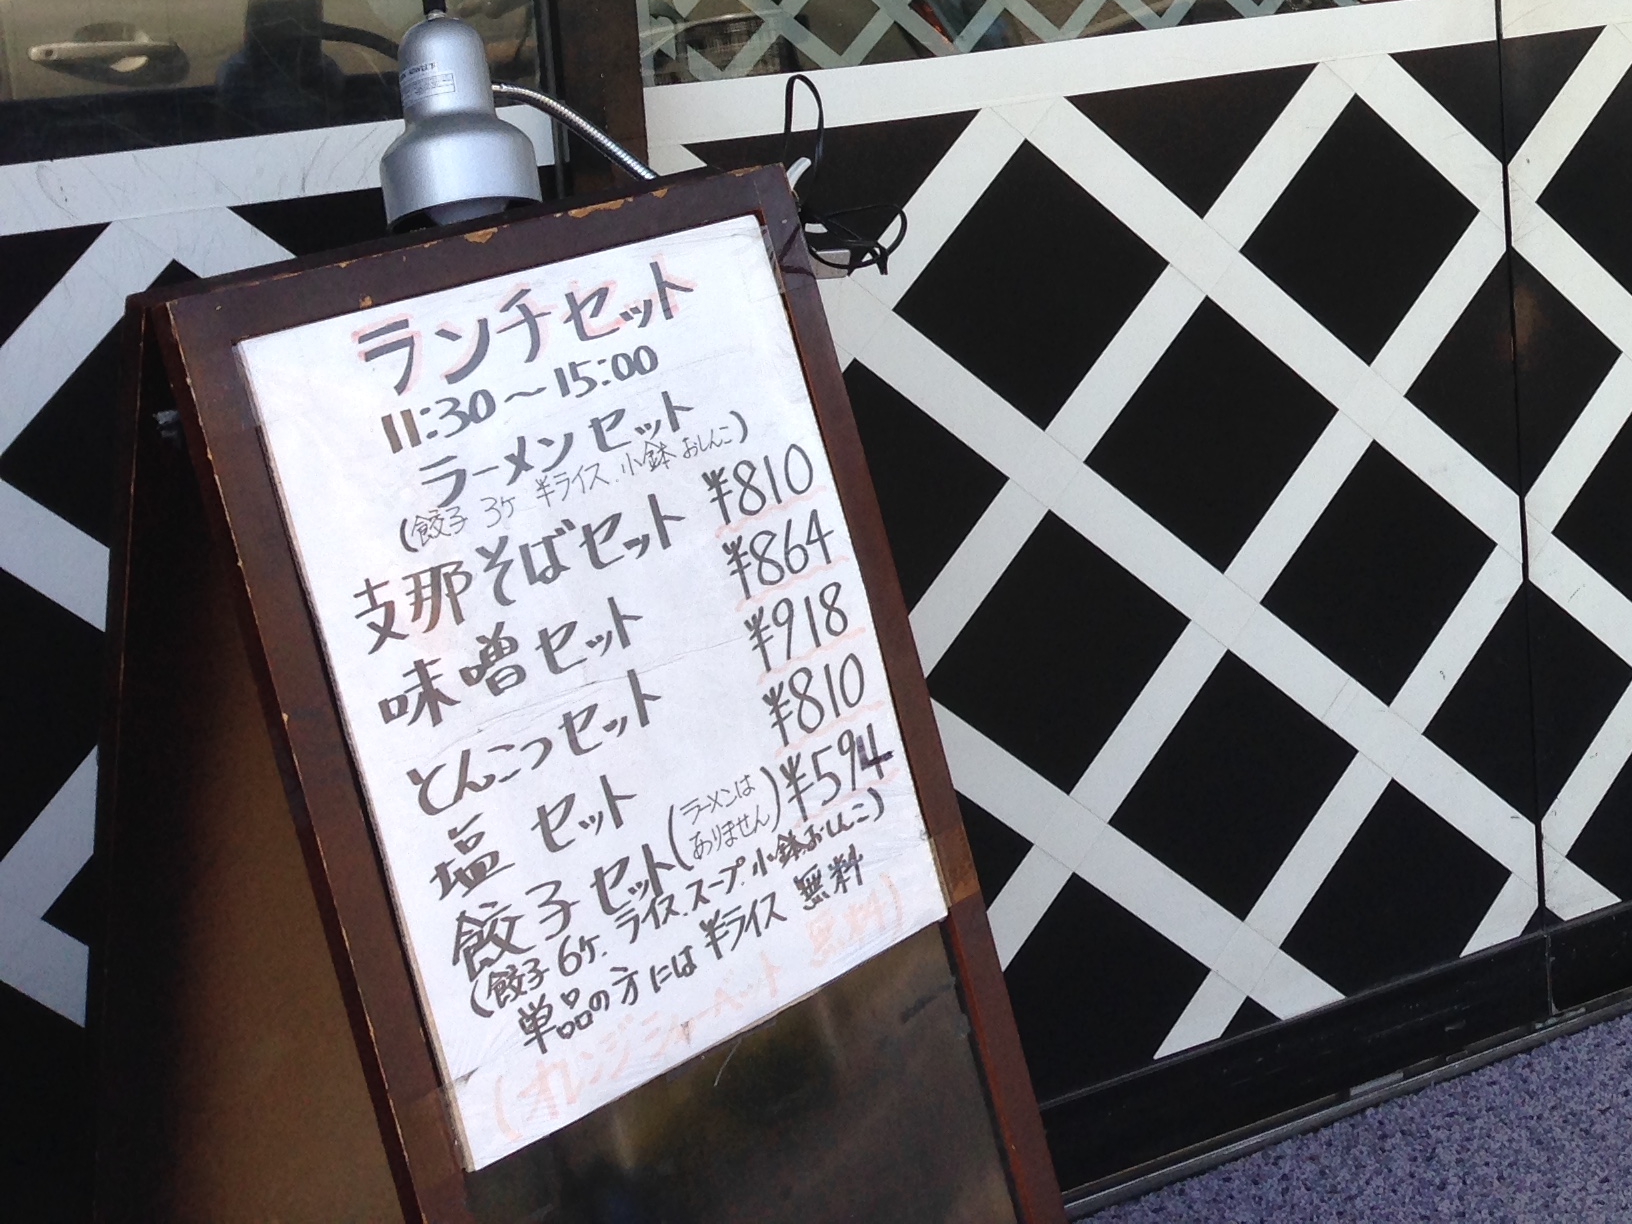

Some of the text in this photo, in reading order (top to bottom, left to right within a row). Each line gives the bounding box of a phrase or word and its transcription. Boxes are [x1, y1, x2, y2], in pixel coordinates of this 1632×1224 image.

[355, 259, 695, 397] ランチセット
[702, 443, 814, 526] ¥810
[722, 508, 835, 601] ¥864
[744, 581, 849, 673] ¥918
[761, 652, 865, 748] ¥810
